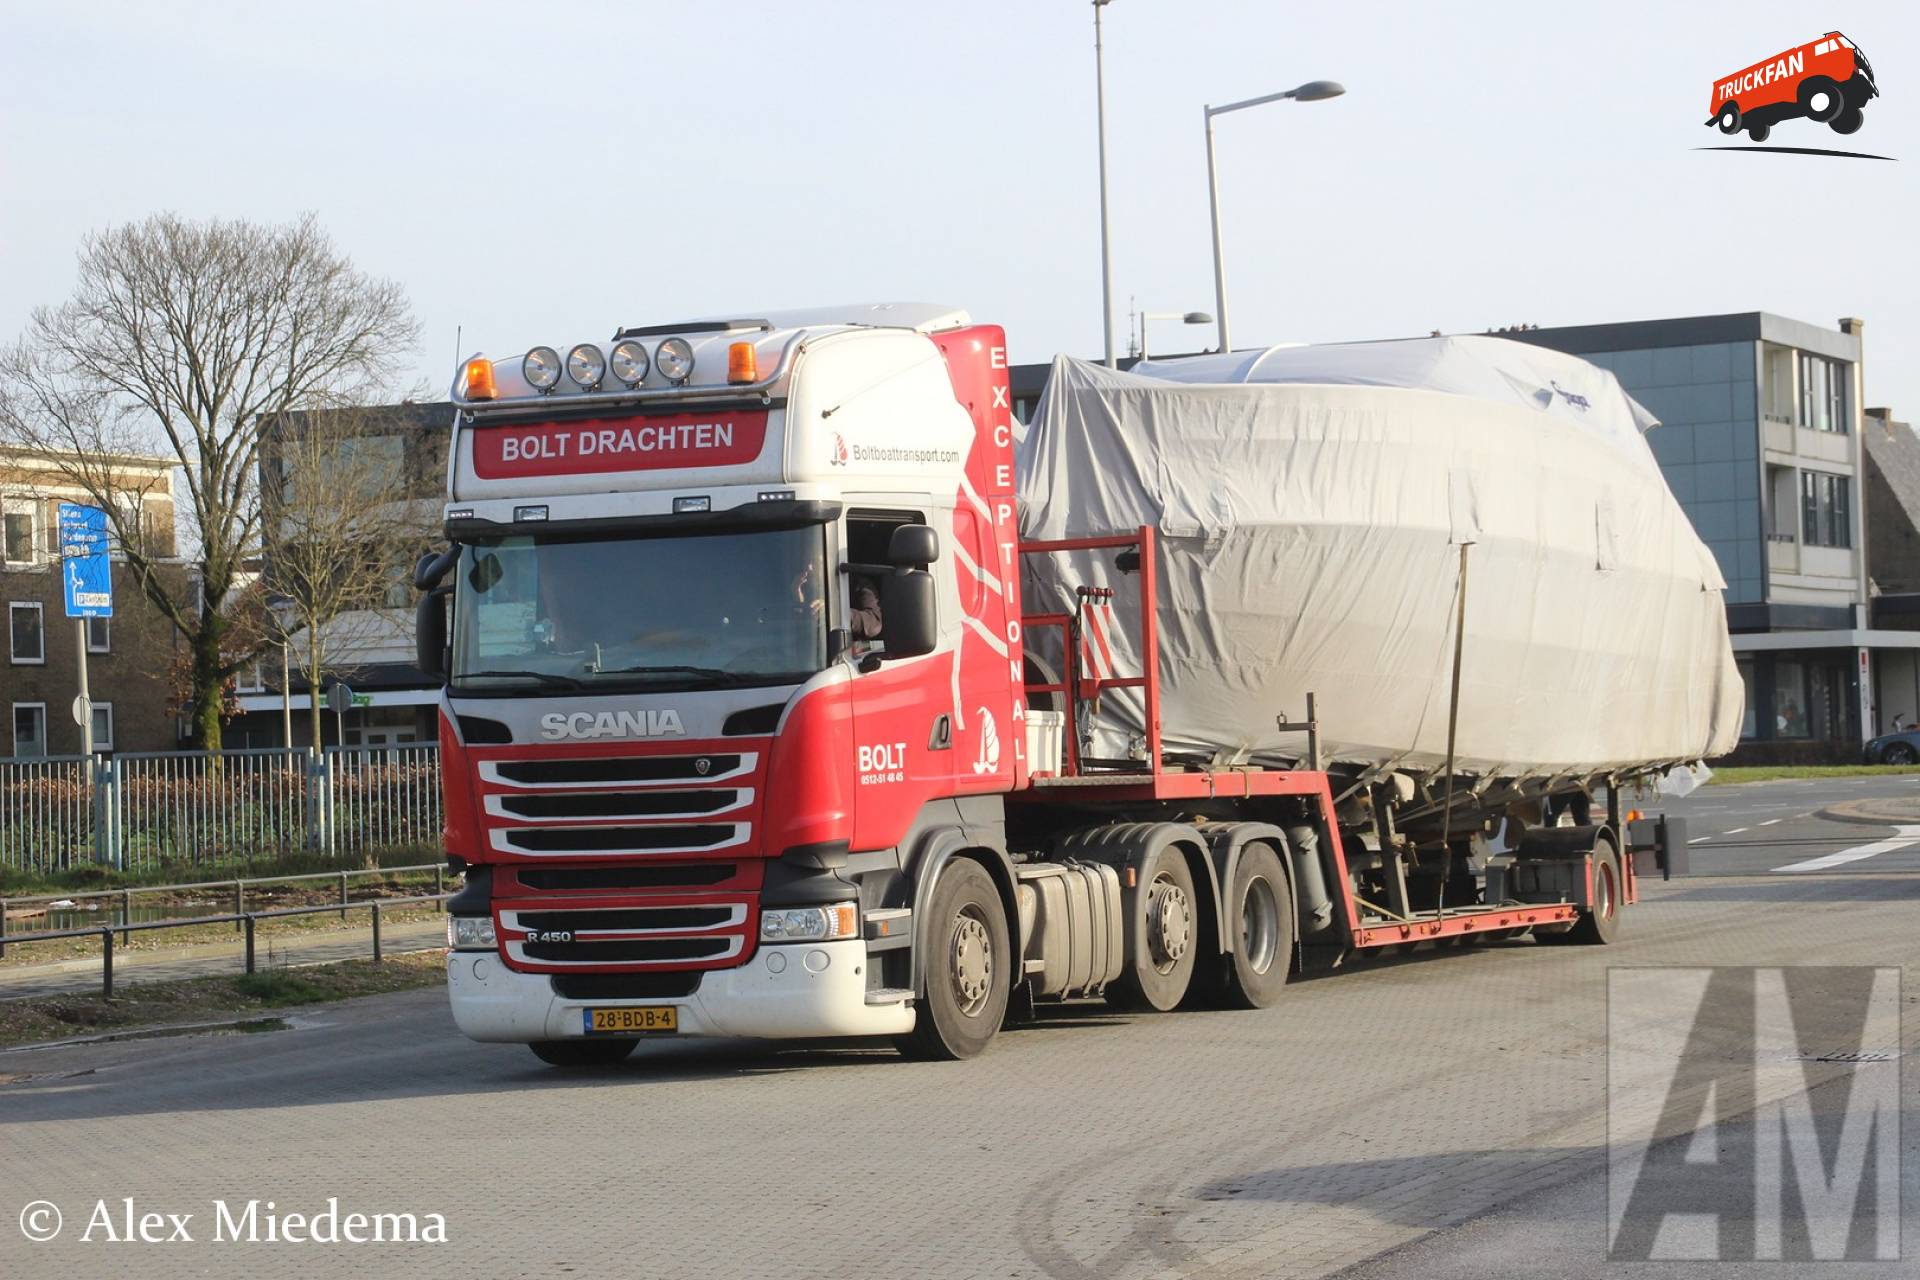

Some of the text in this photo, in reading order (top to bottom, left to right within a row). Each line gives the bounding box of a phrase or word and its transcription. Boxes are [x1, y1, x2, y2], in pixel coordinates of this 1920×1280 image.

[502, 423, 733, 461] BOLT DRACHTEN
[852, 444, 960, 464] Boltboattransport.com
[990, 346, 1025, 760] EXCEPTIONAL
[541, 709, 686, 740] SCANIA
[858, 742, 907, 772] BOLT
[527, 931, 571, 943] R 450
